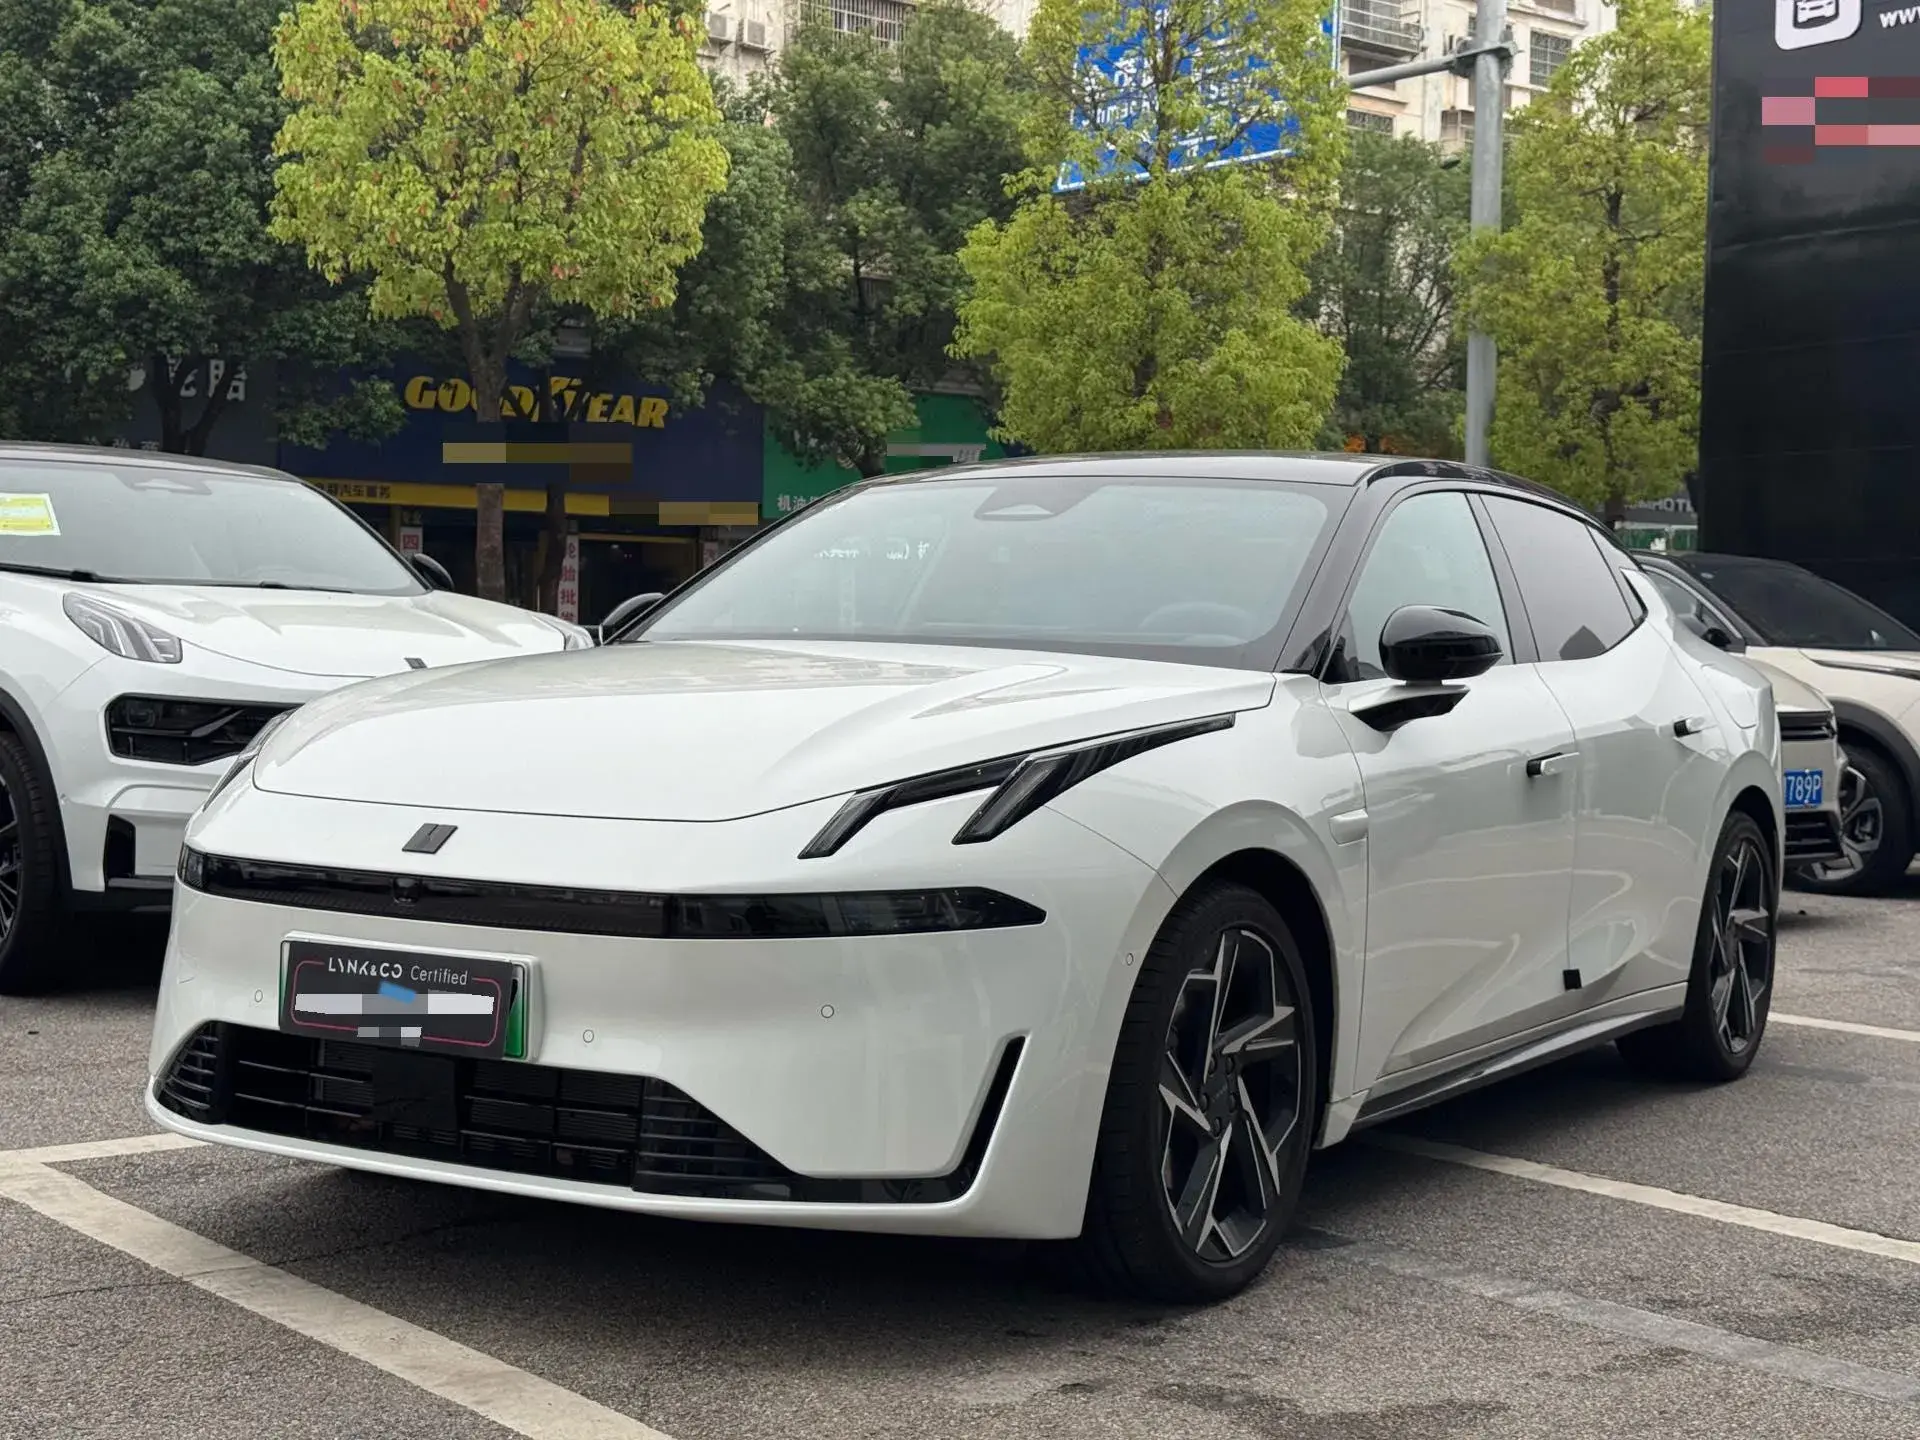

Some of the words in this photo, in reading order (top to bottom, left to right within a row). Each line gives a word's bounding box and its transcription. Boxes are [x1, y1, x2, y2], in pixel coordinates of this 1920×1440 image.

[1880, 6, 1920, 28] ww
[1783, 774, 1821, 802] 789P
[410, 965, 468, 986] Certified
